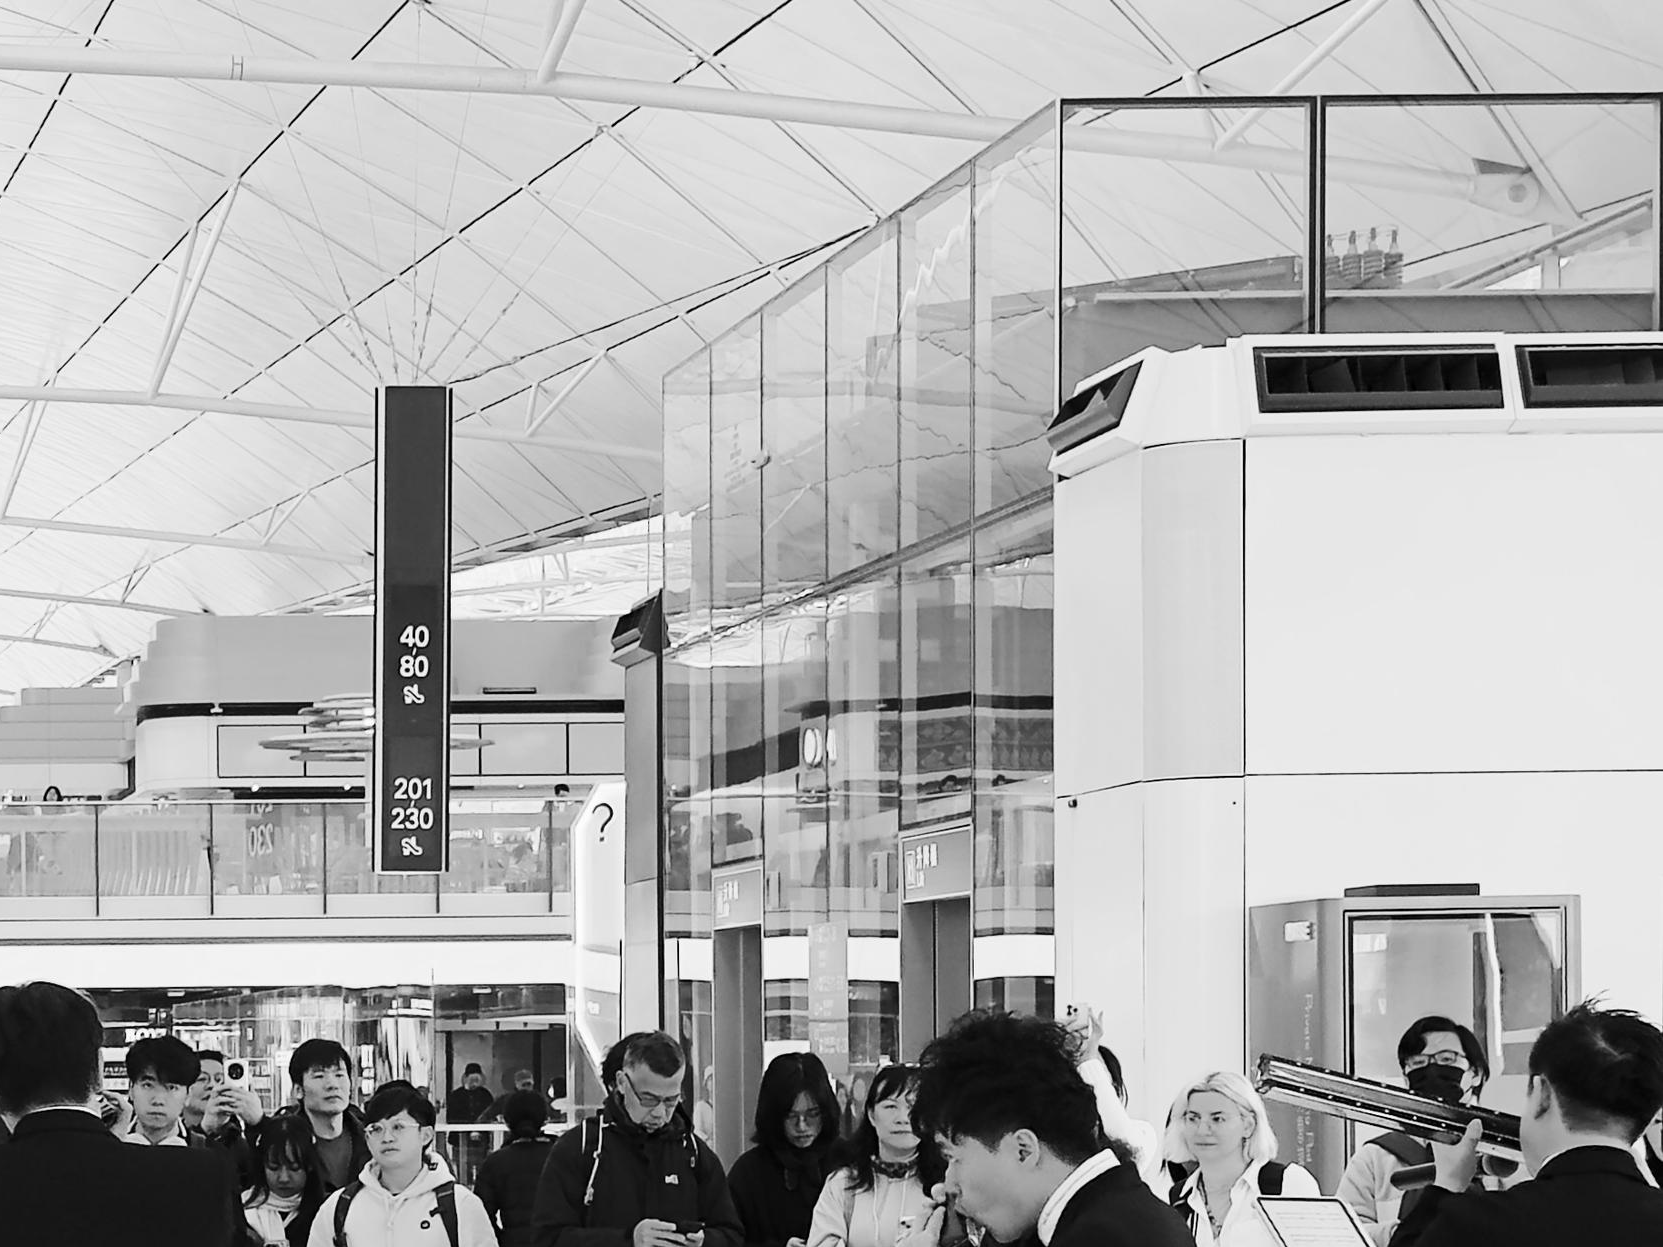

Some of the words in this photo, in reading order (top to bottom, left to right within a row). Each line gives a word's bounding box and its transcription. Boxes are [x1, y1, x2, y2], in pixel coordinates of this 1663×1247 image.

[399, 626, 429, 648] 40
[399, 655, 429, 678] 80
[394, 778, 432, 800] 201
[391, 807, 434, 830] 230
